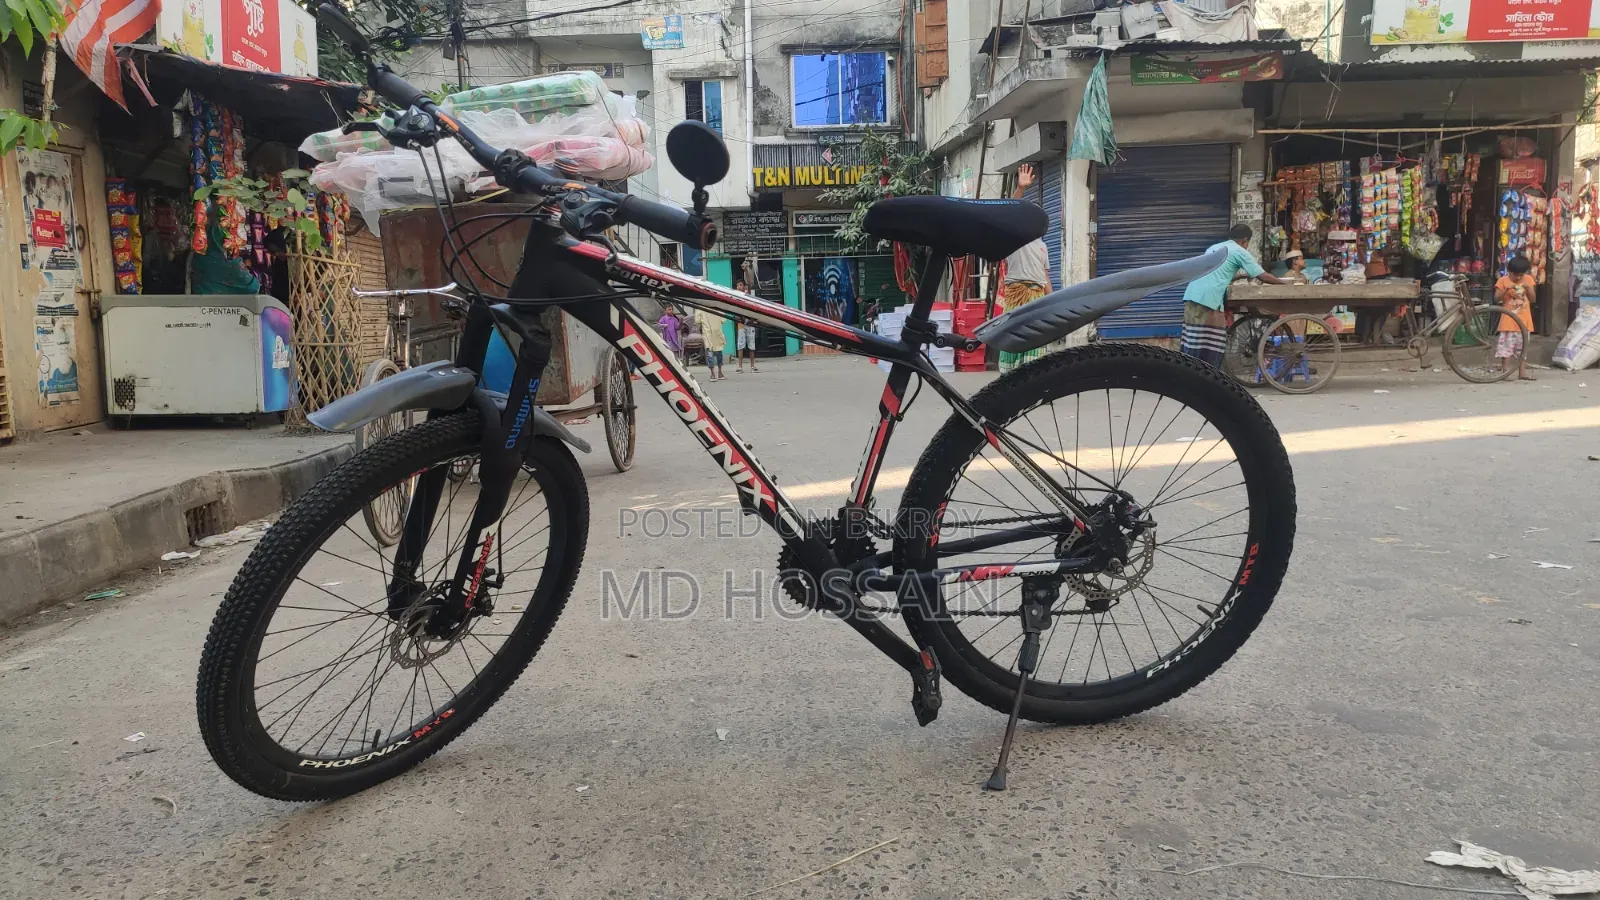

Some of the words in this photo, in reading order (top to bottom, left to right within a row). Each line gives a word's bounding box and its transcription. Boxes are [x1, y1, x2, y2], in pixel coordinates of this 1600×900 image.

[1505, 11, 1532, 23] সাবিনা
[753, 167, 791, 187] T&N
[795, 166, 870, 187] MULTIM
[201, 307, 241, 316] C-PENTANE
[616, 333, 776, 511] PHOENIX
[1146, 587, 1243, 679] PHOENIX
[299, 736, 412, 769] PHOENIX
